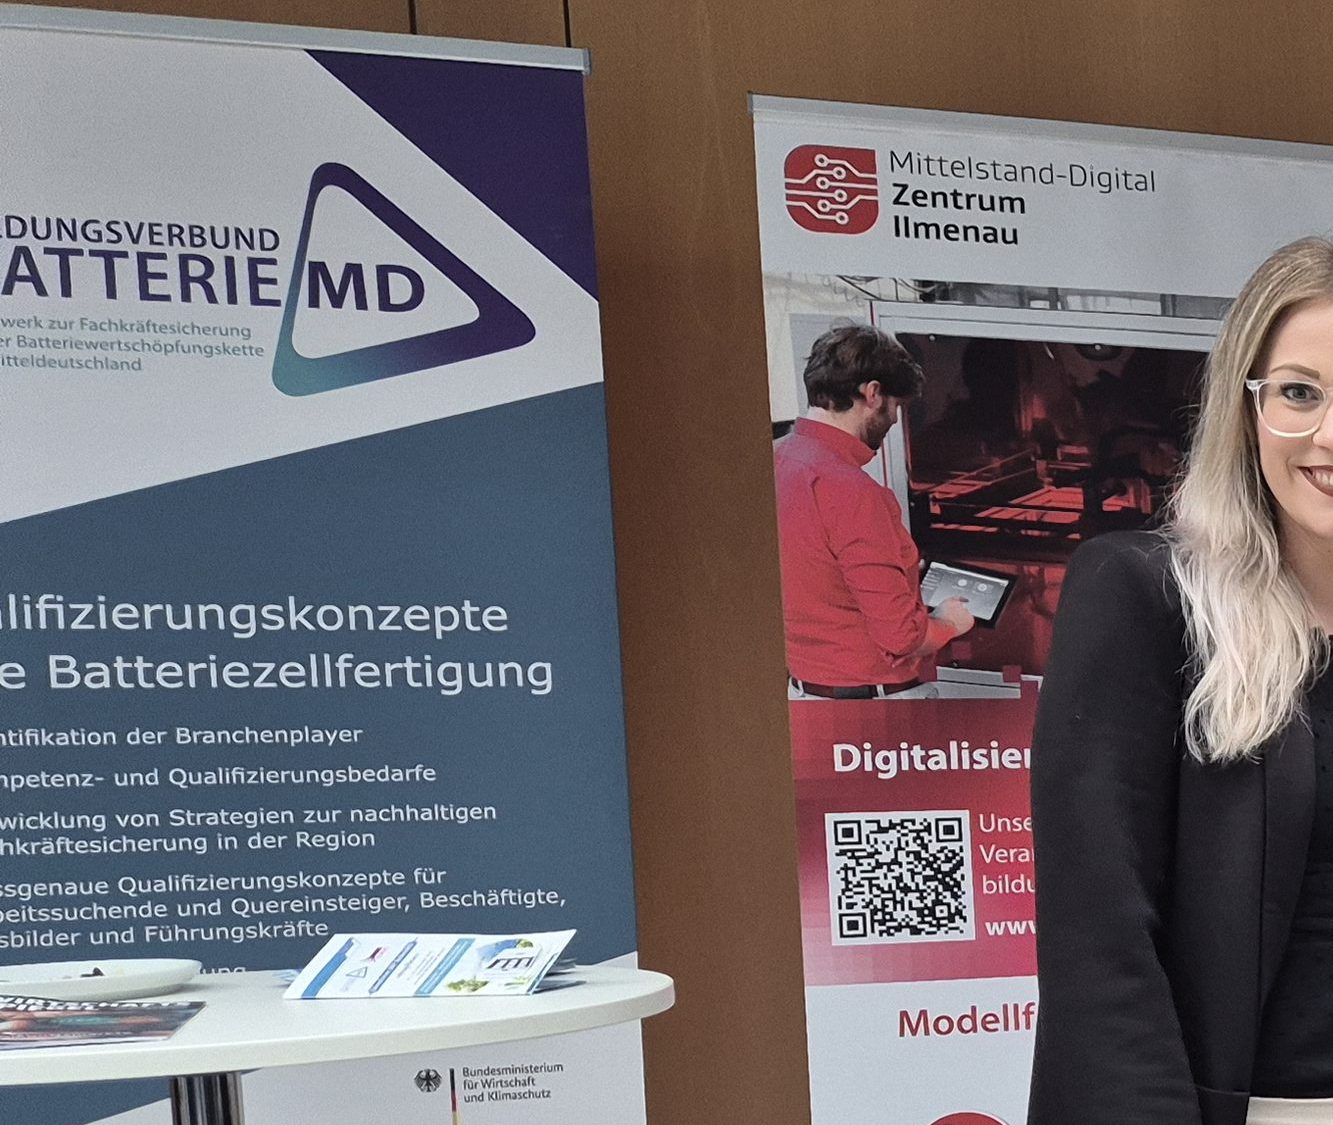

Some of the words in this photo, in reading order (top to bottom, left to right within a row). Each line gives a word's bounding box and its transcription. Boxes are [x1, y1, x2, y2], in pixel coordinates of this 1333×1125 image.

[889, 149, 1156, 194] Mittelstand-Digital
[891, 182, 1026, 214] Zentrum
[892, 214, 1019, 246] Ilmenau
[308, 260, 425, 313] MD
[48, 319, 75, 331] zur
[79, 317, 252, 342] Fachkräftesicherung
[17, 334, 265, 358] Batteriewertschöpfungskette
[0, 593, 509, 640] lifizierungskonzepte
[48, 652, 553, 696] Batteriezellfertigung
[126, 727, 168, 745] der
[175, 725, 364, 748] Branchenplayer
[113, 768, 160, 787] und
[168, 764, 437, 789] Qualifizierungsbedarfe
[115, 813, 161, 828] von
[168, 807, 295, 828] Strategien
[303, 809, 343, 824] zur
[350, 803, 497, 825] nachhaltigen
[216, 833, 239, 849] in
[247, 831, 289, 850] der
[295, 831, 376, 851] Region
[117, 869, 406, 897] Qualifizierungskonzepte
[413, 867, 448, 885] für
[177, 898, 222, 917] und
[230, 894, 410, 918] Quereinsteiger,
[418, 887, 566, 909] Beschäftigte,
[89, 926, 135, 945] und
[144, 919, 329, 943] Führungskräfte
[898, 1001, 1036, 1038] Modellf
[462, 1062, 564, 1077] Bundesministerium
[463, 1079, 479, 1091] für
[480, 1075, 536, 1089] Wirtschaft
[464, 1091, 485, 1103] und
[488, 1088, 552, 1102] Klimaschutz
